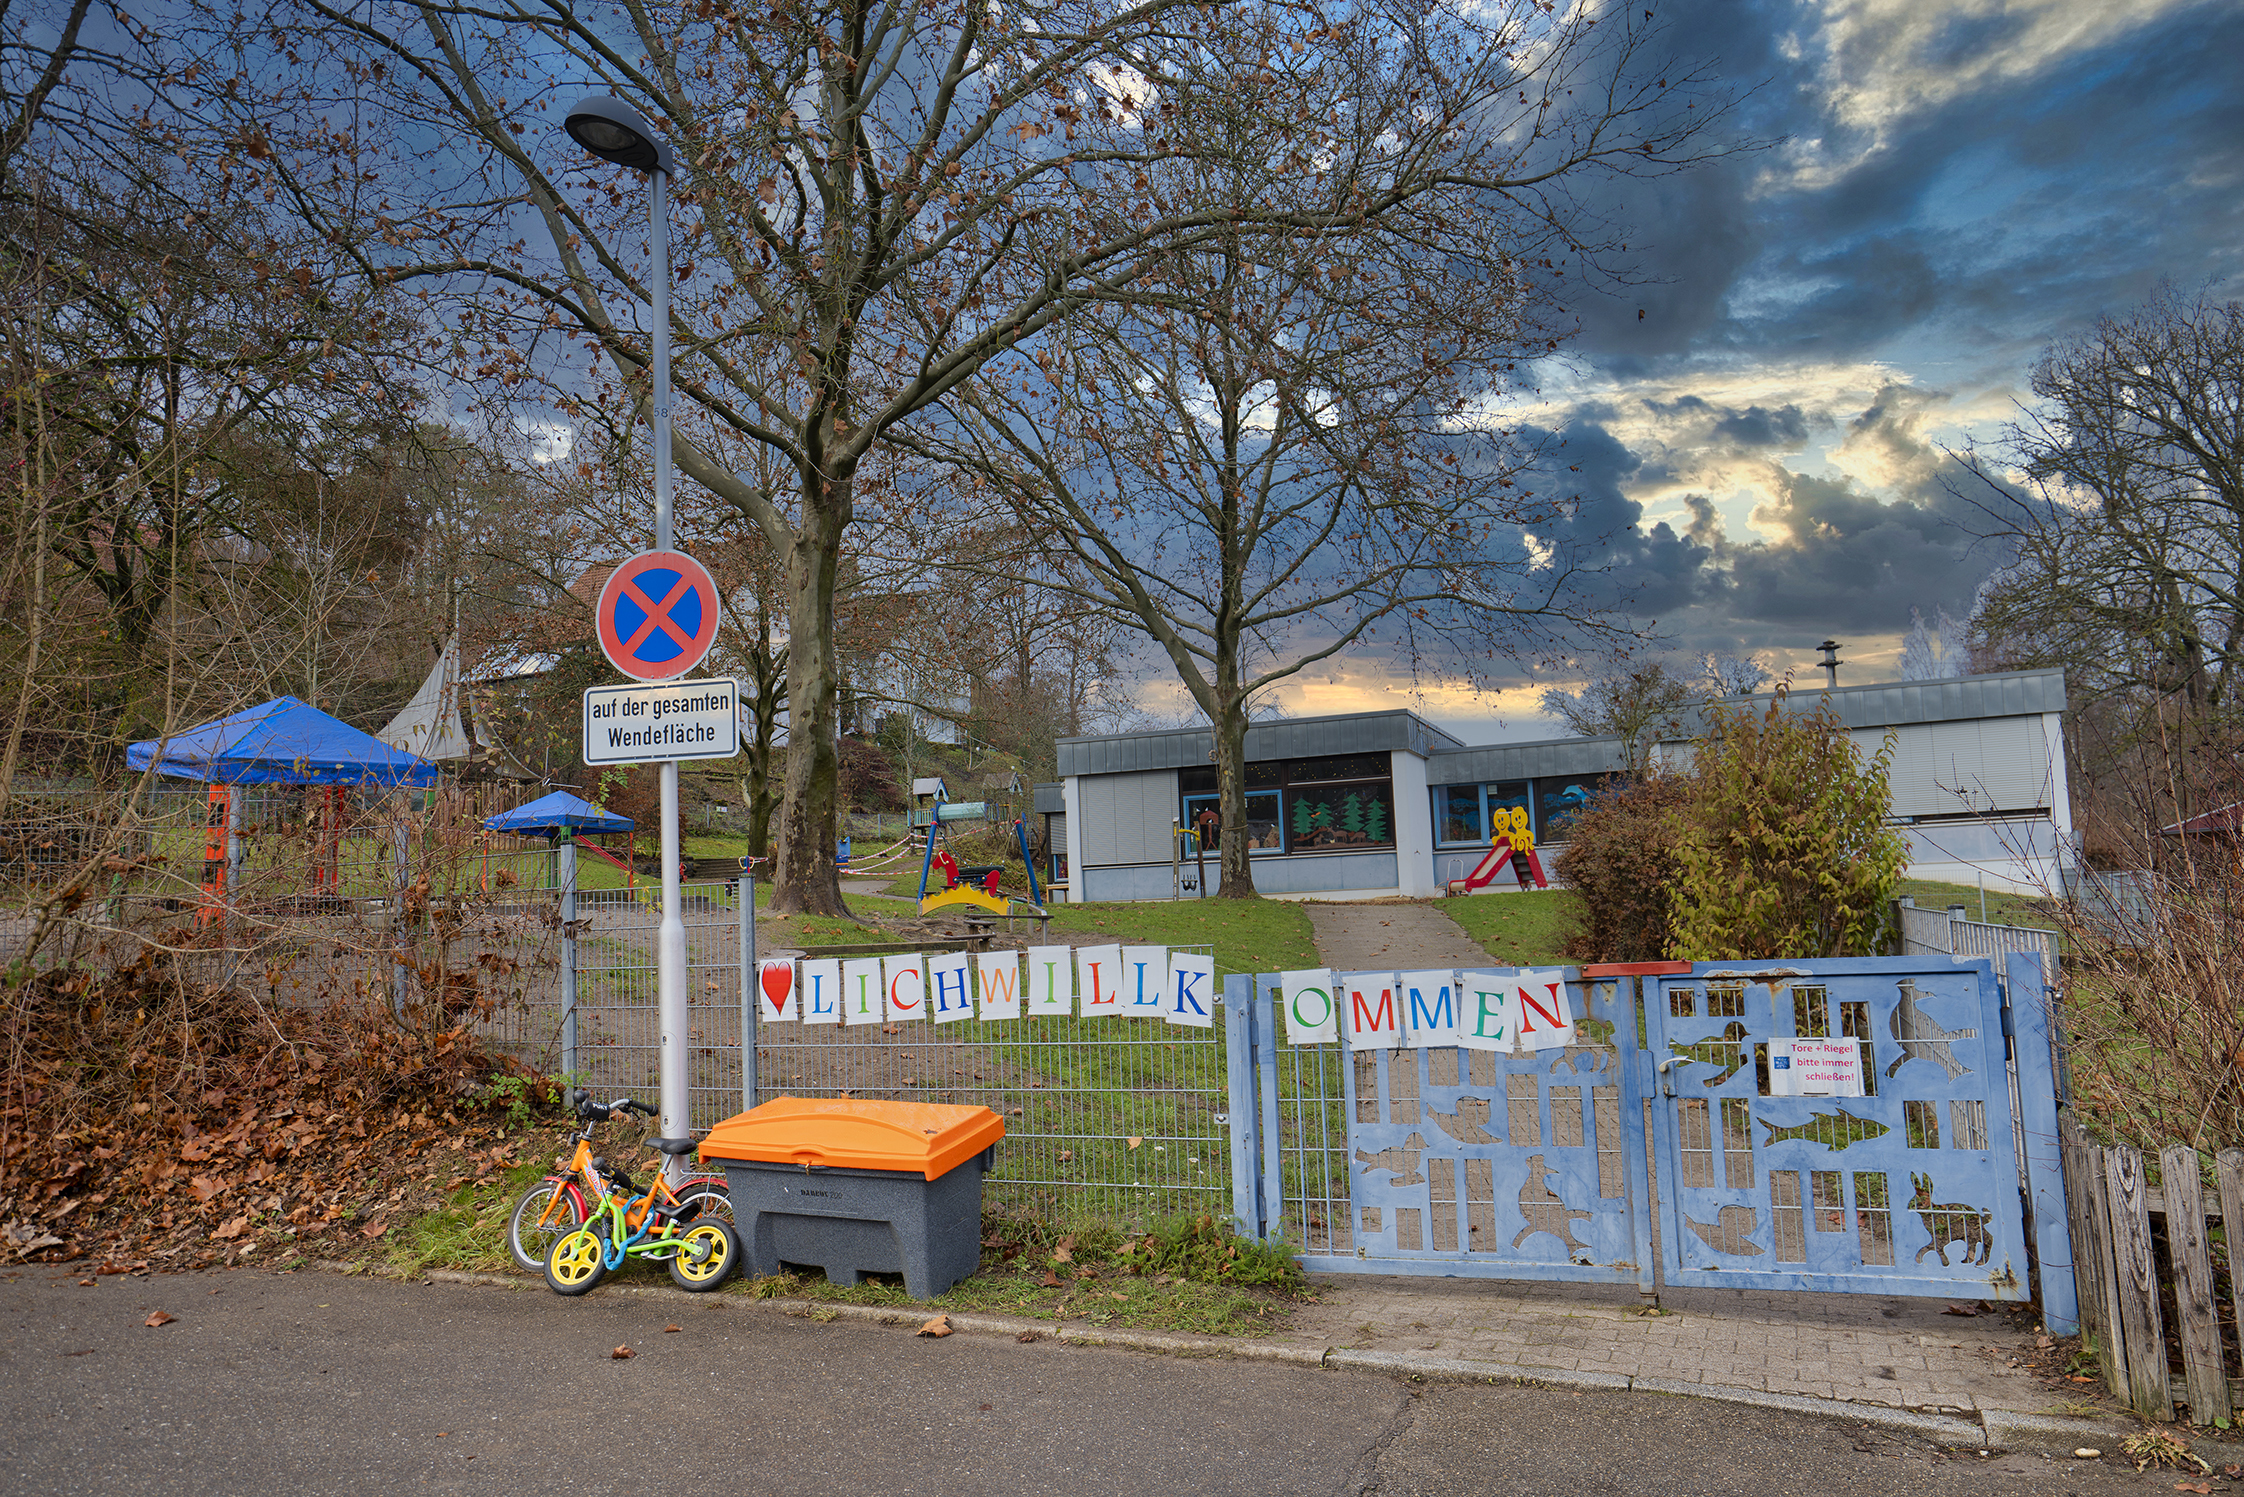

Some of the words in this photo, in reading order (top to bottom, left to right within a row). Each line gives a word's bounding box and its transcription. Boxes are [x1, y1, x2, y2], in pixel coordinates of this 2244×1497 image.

[653, 407, 669, 418] 58
[592, 698, 617, 718] auf
[622, 697, 649, 717] der
[653, 692, 729, 720] gesamten
[608, 722, 715, 748] Wendefläche
[1791, 1044, 1813, 1053] Tore
[1824, 1044, 1853, 1054] Riegel
[1797, 1058, 1820, 1066] bitte
[1822, 1058, 1854, 1067] immer
[1805, 1072, 1855, 1081] schließen!
